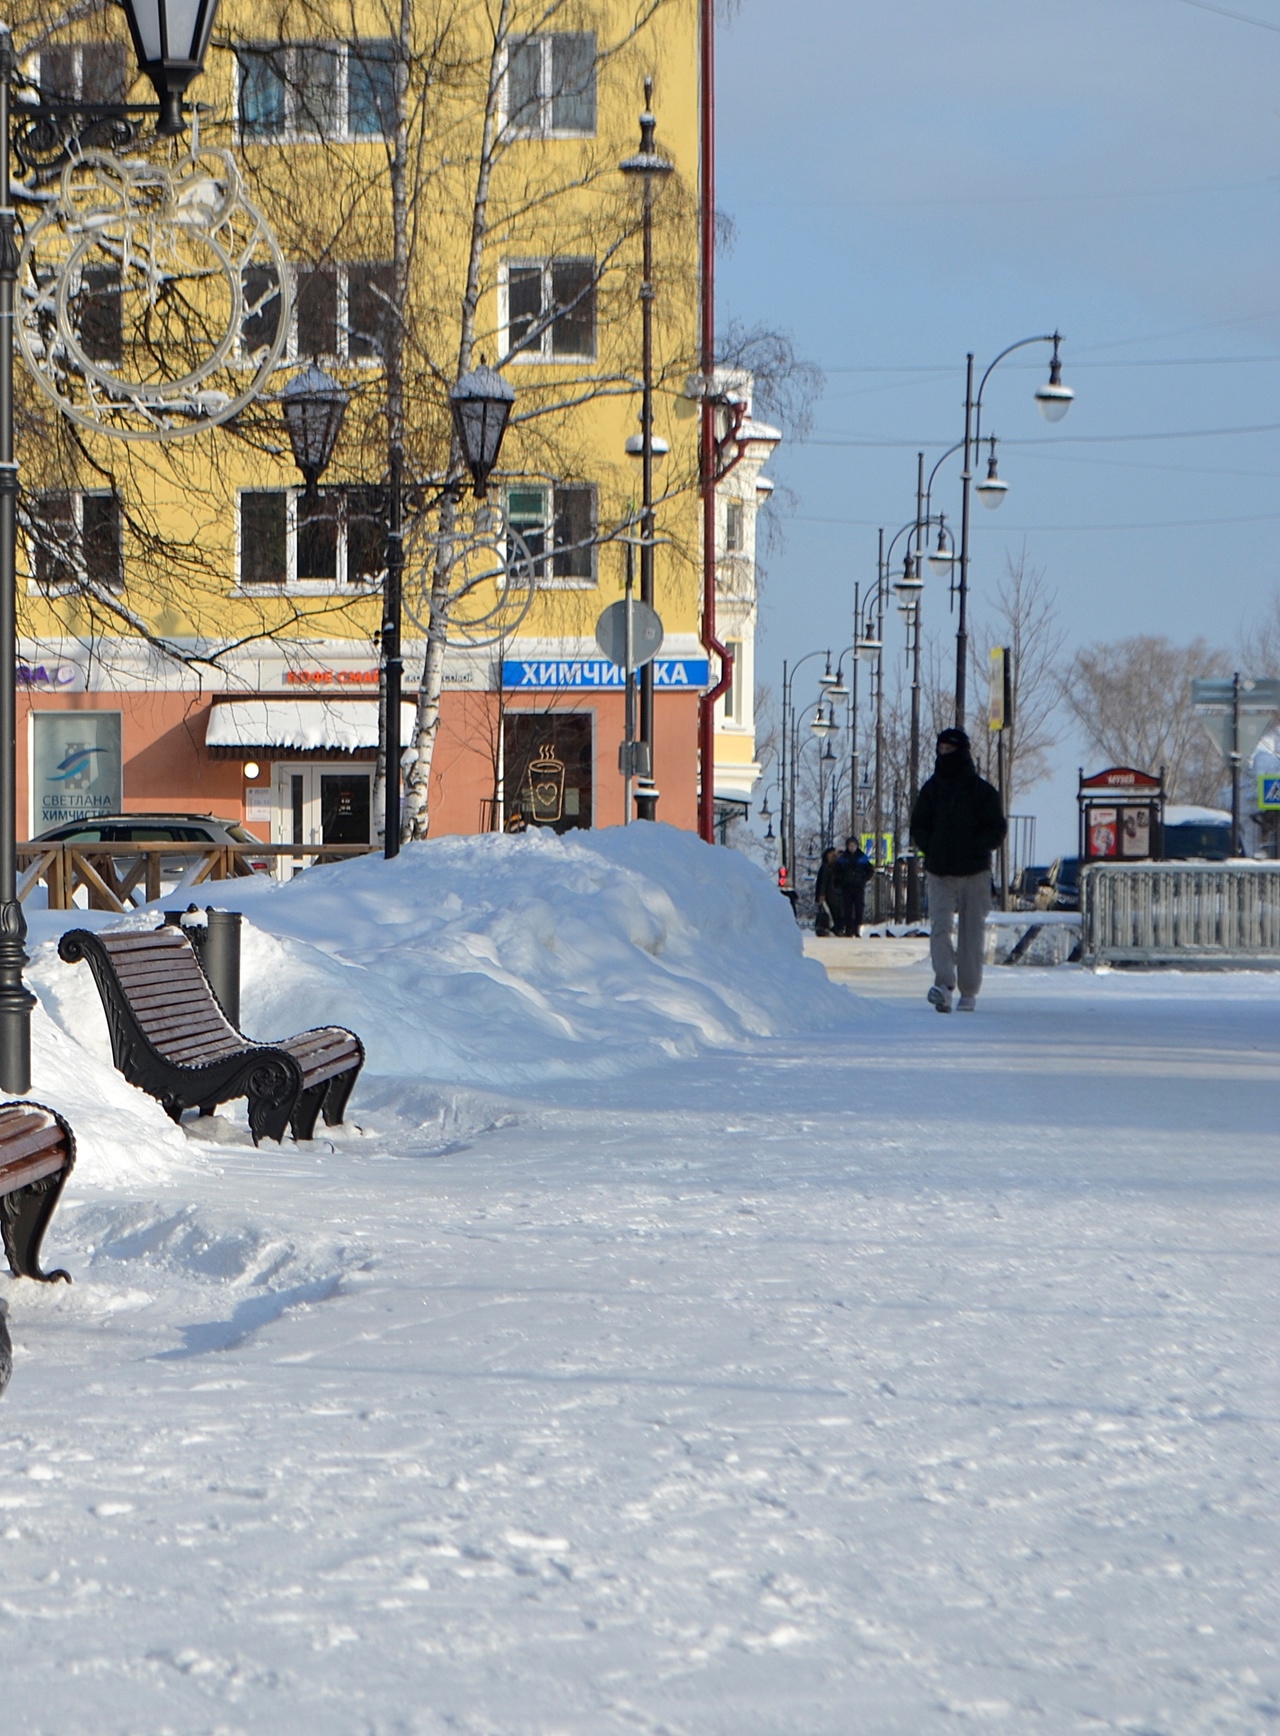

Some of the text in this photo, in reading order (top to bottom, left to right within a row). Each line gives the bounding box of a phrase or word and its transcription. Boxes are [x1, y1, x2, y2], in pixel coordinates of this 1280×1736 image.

[287, 671, 332, 684] КОФЕ
[521, 662, 688, 684] ХИМЧИКА
[42, 795, 112, 806] СВЕТЛАНА
